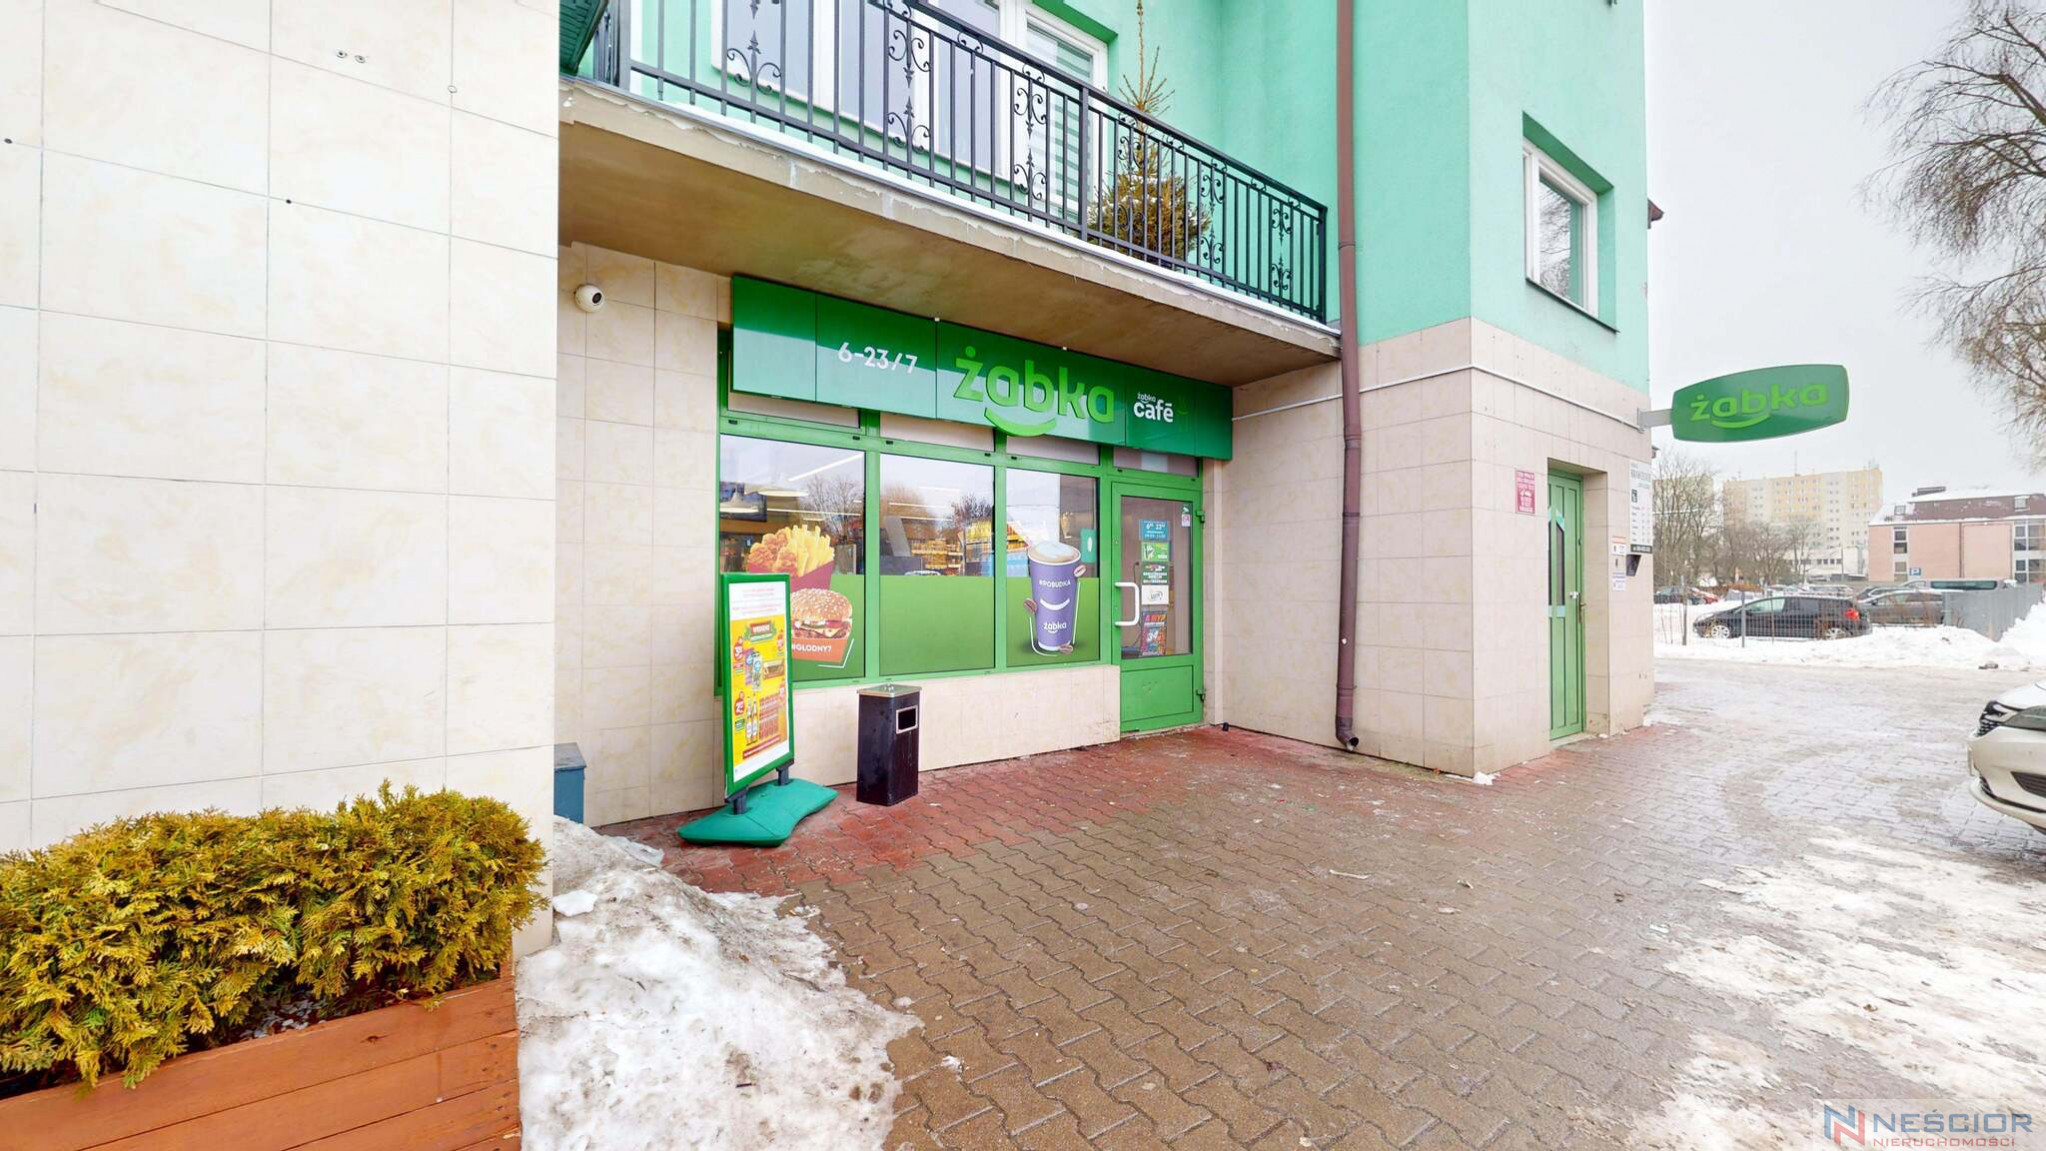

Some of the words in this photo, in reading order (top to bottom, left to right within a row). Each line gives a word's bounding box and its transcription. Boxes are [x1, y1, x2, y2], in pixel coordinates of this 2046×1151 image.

[838, 342, 918, 374] 6-23/7
[953, 346, 1115, 424] żabka
[1690, 384, 1828, 421] żabka
